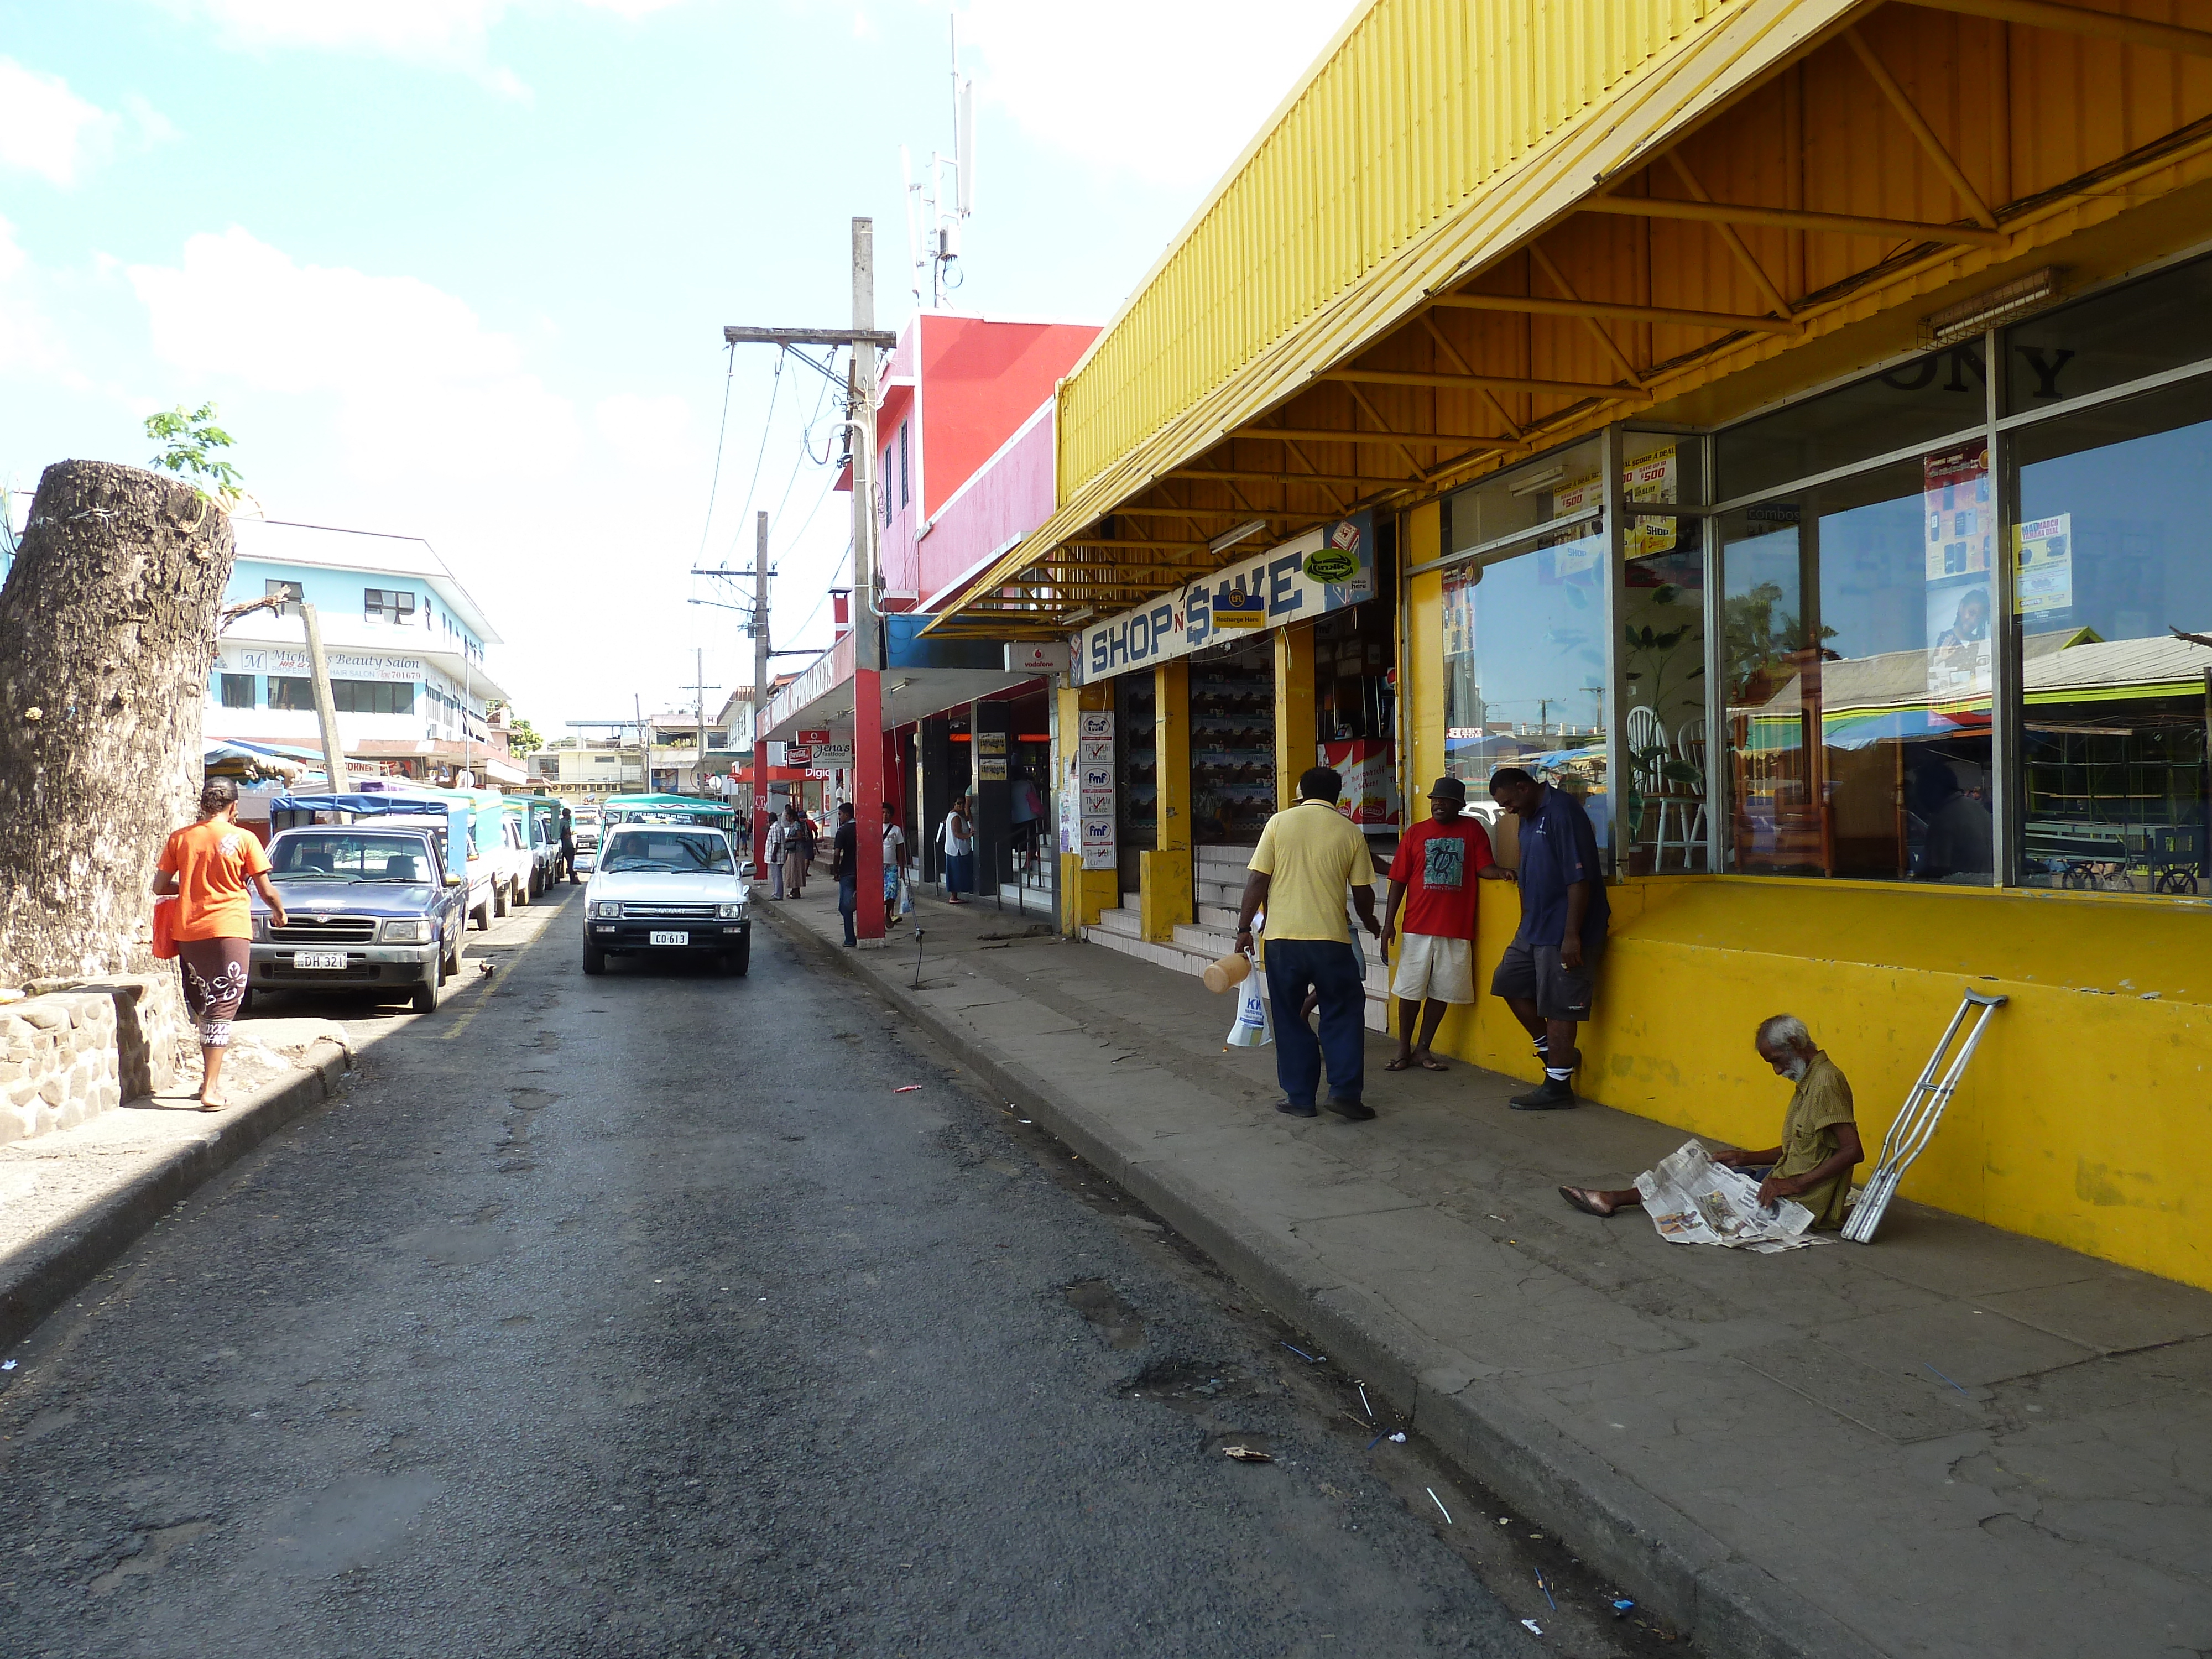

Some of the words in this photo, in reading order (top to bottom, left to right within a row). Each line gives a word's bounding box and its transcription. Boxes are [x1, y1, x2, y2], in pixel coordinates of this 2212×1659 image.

[1641, 467, 1665, 482] $500
[1563, 494, 1582, 508] $500
[1749, 506, 1800, 520] combos
[1647, 525, 1669, 536] SHOP
[1091, 603, 1172, 674] SHOP
[244, 653, 264, 669] M
[336, 654, 383, 670] Beauty
[385, 656, 419, 669] Salon
[392, 671, 421, 679] 701679
[1089, 772, 1107, 784] fmf
[1089, 825, 1108, 836] fmf
[669, 934, 685, 943] 613
[305, 956, 320, 967] DH
[324, 956, 342, 968] 321
